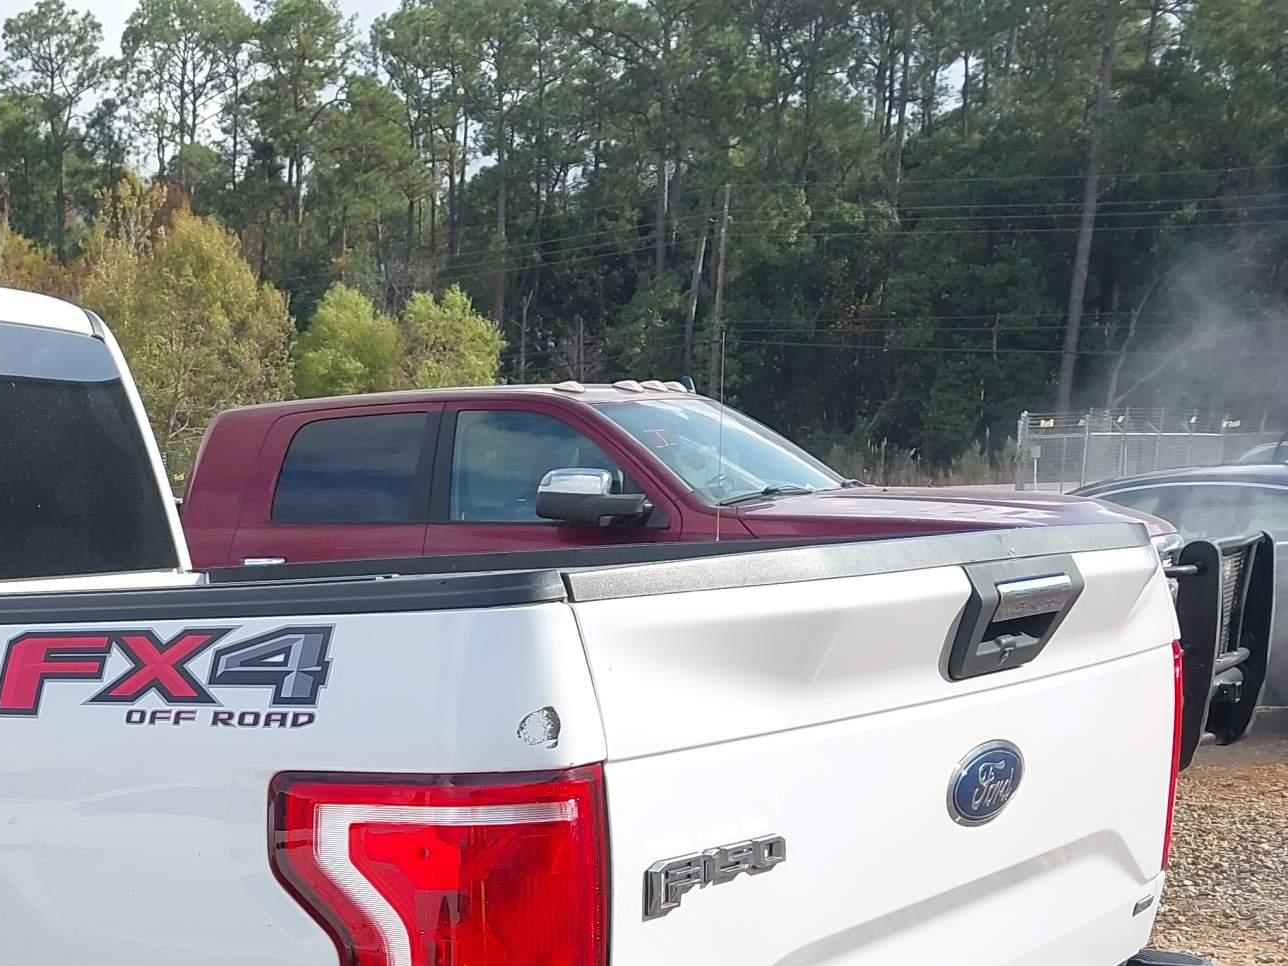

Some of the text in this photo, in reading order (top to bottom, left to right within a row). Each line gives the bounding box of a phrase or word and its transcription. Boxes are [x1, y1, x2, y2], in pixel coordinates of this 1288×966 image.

[125, 709, 317, 728] OFF ROAD
[970, 759, 1015, 810] Ford
